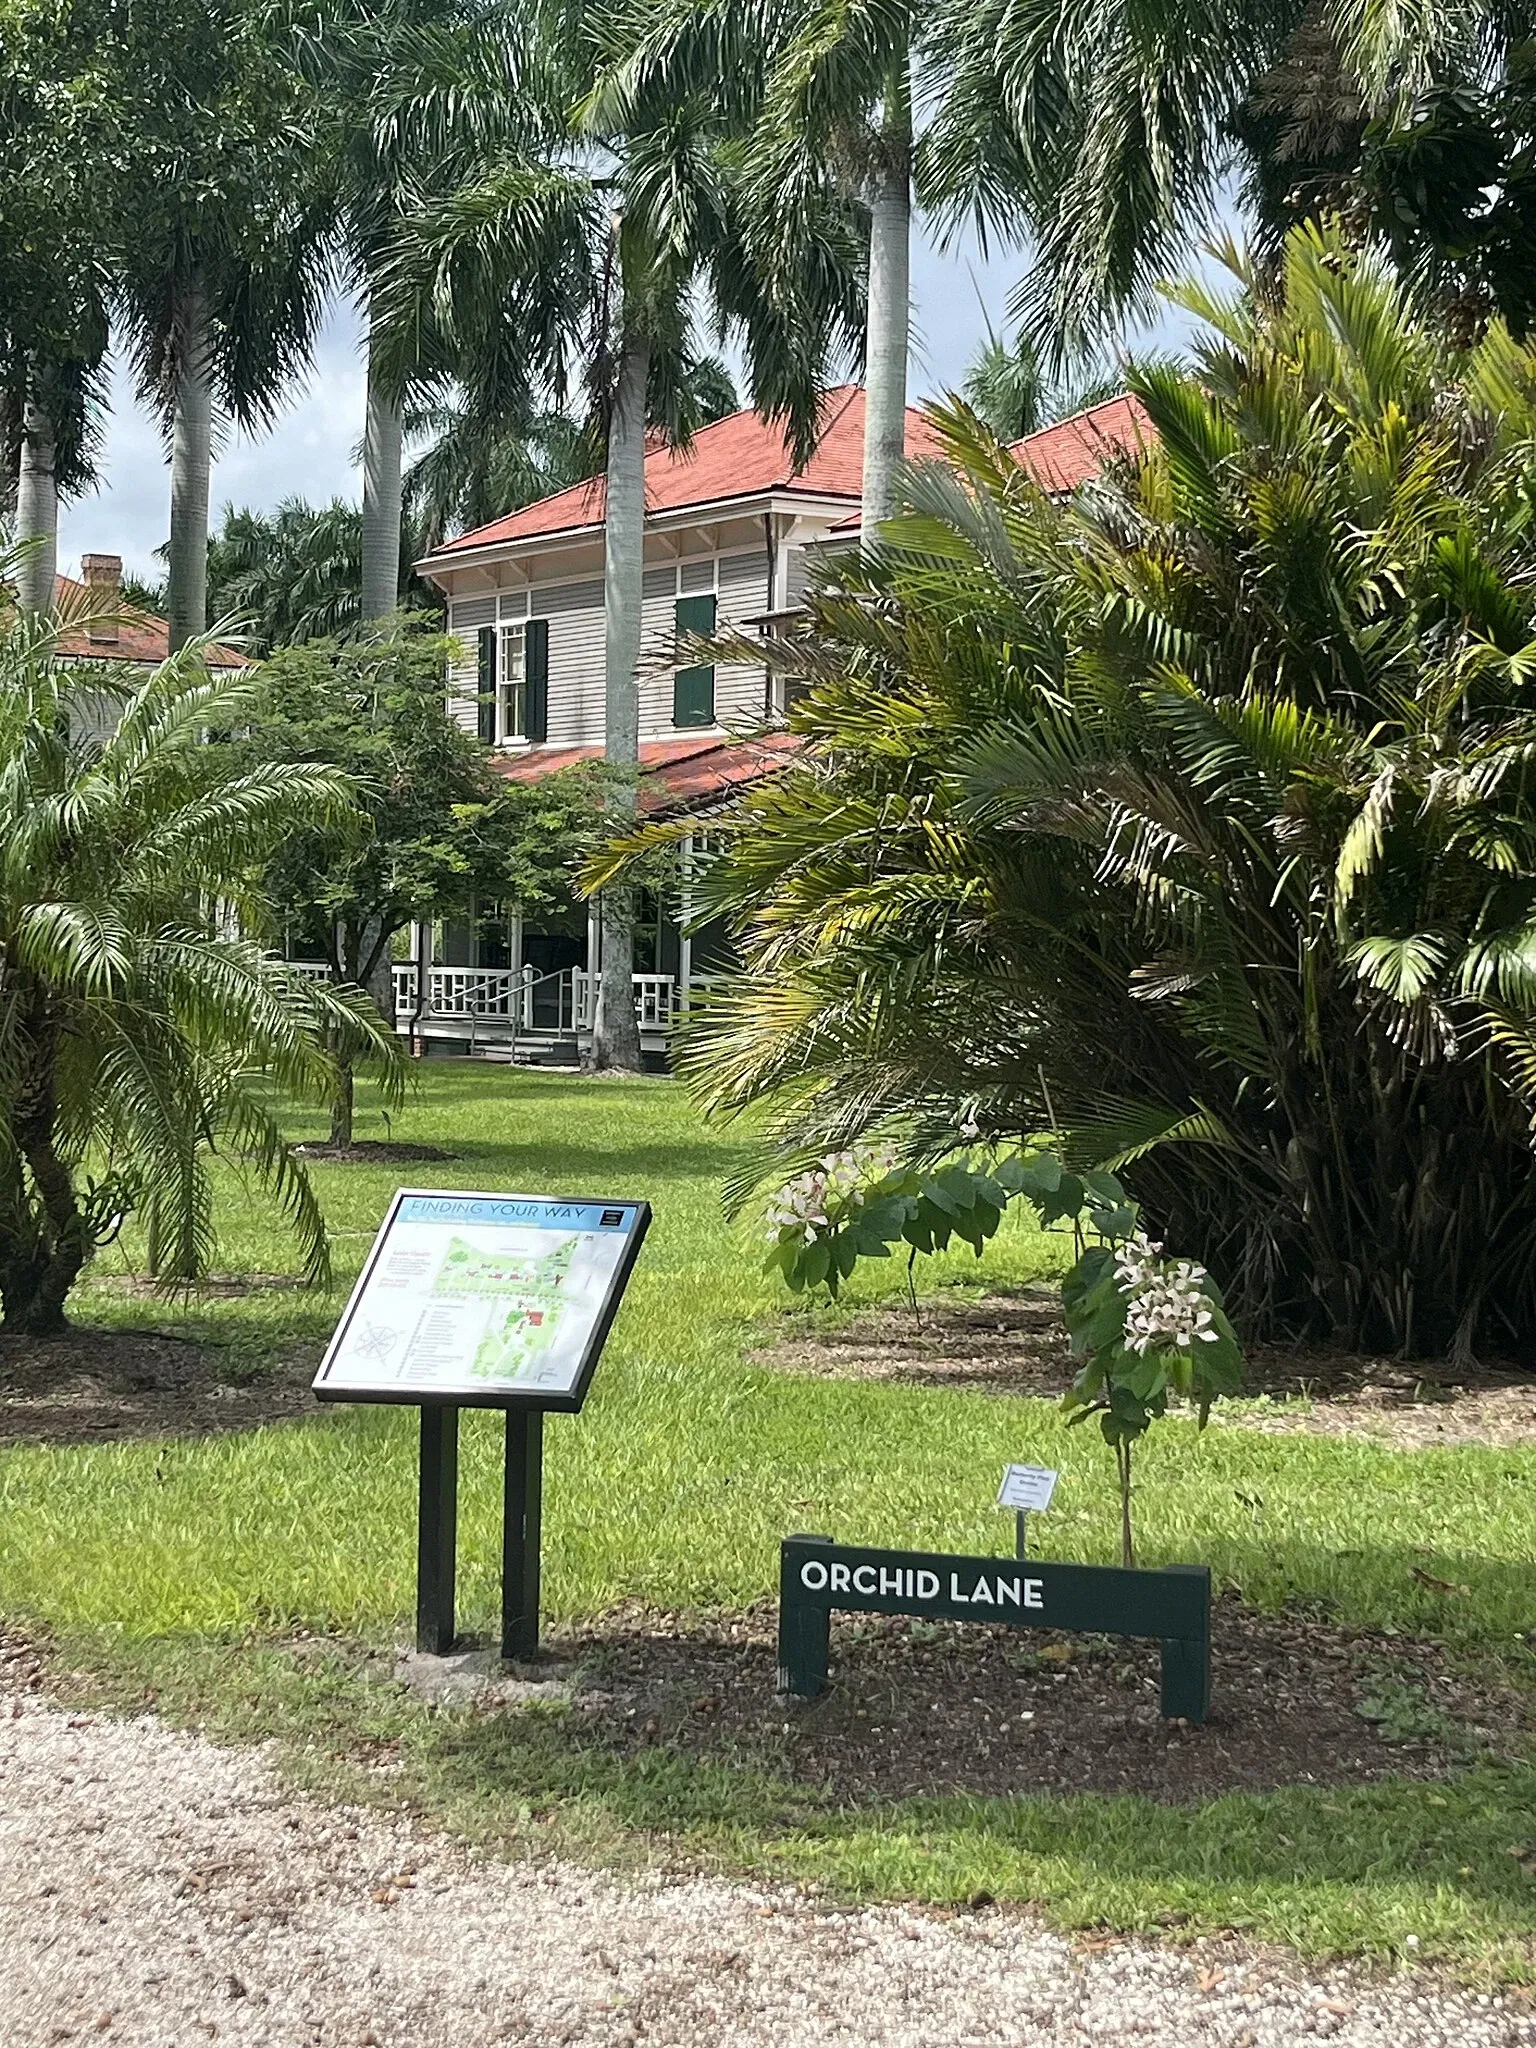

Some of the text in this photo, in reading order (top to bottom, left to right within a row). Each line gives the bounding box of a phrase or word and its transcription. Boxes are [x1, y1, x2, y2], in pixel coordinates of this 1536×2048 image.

[411, 1200, 587, 1219] FINDING YOUR WAY
[800, 1561, 1044, 1608] ORCHID LANE
